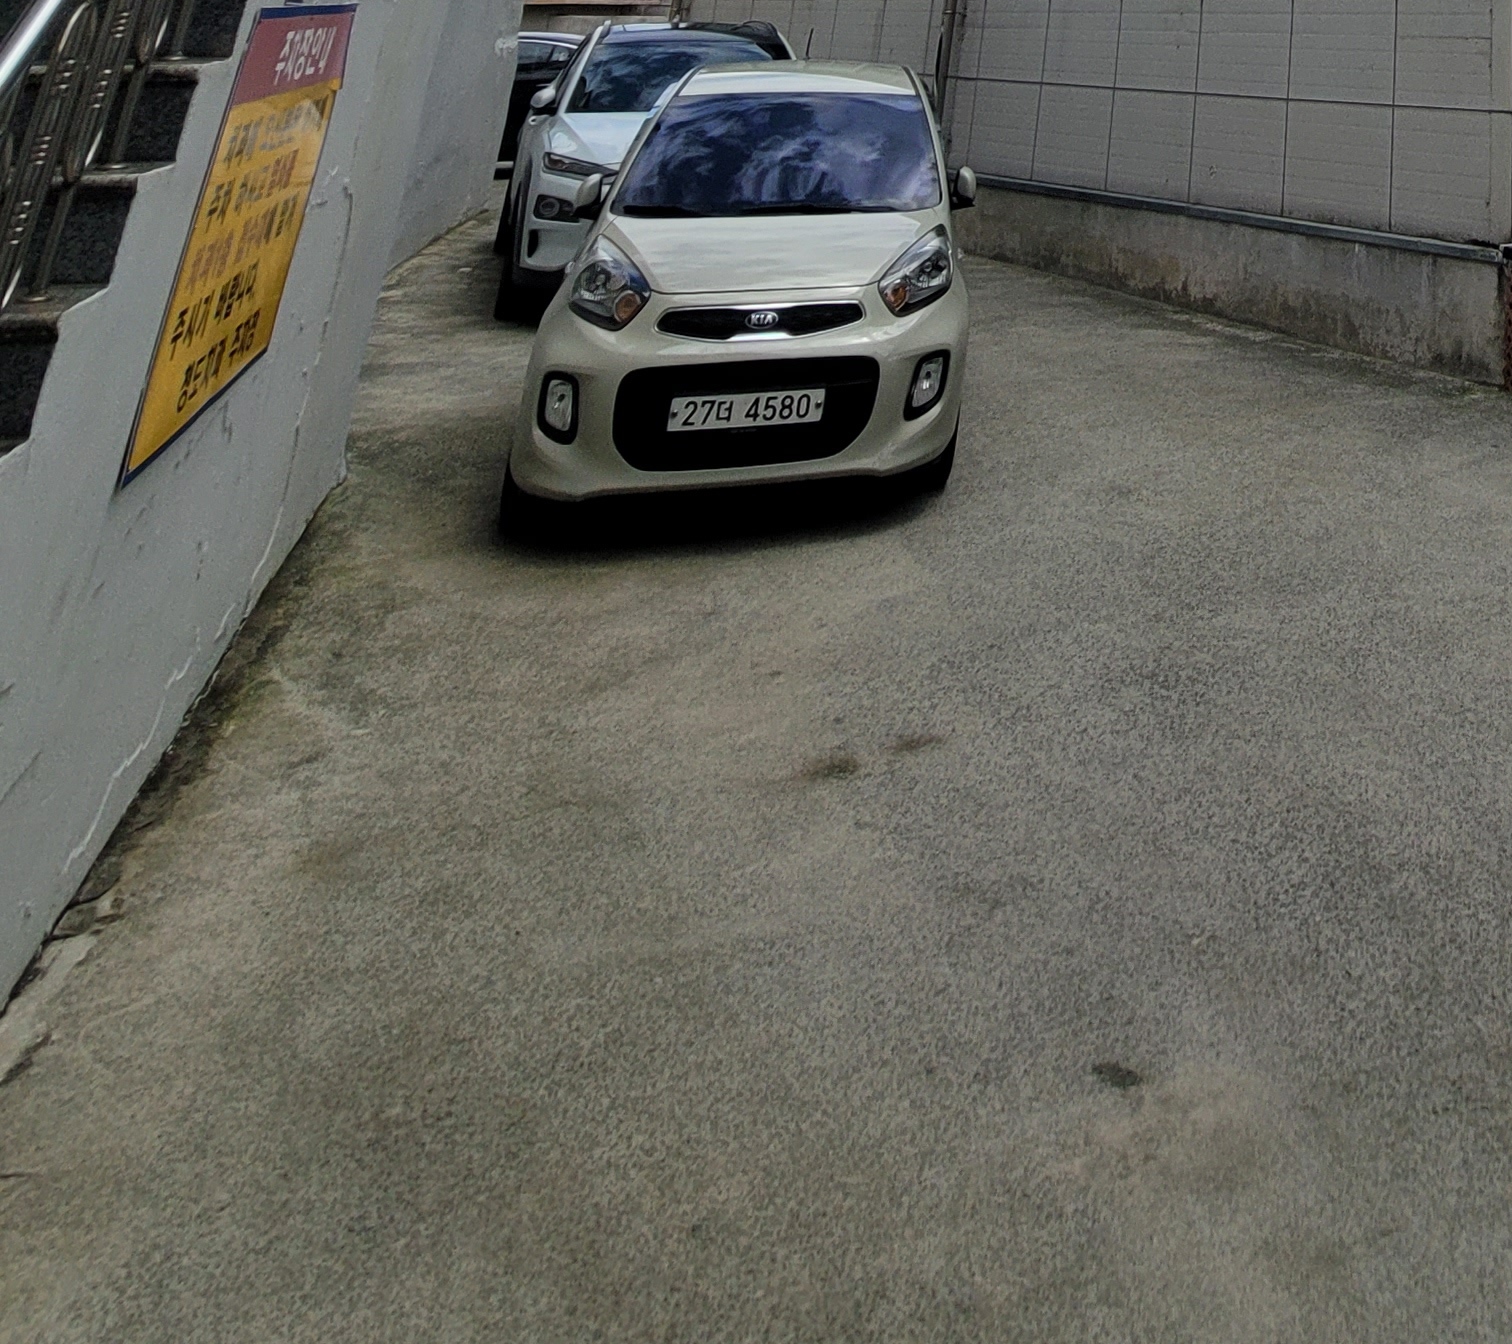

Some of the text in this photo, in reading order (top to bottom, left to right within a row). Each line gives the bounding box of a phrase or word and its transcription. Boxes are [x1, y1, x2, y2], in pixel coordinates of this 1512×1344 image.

[750, 313, 774, 326] KIA
[680, 393, 812, 427] 27더 4580
